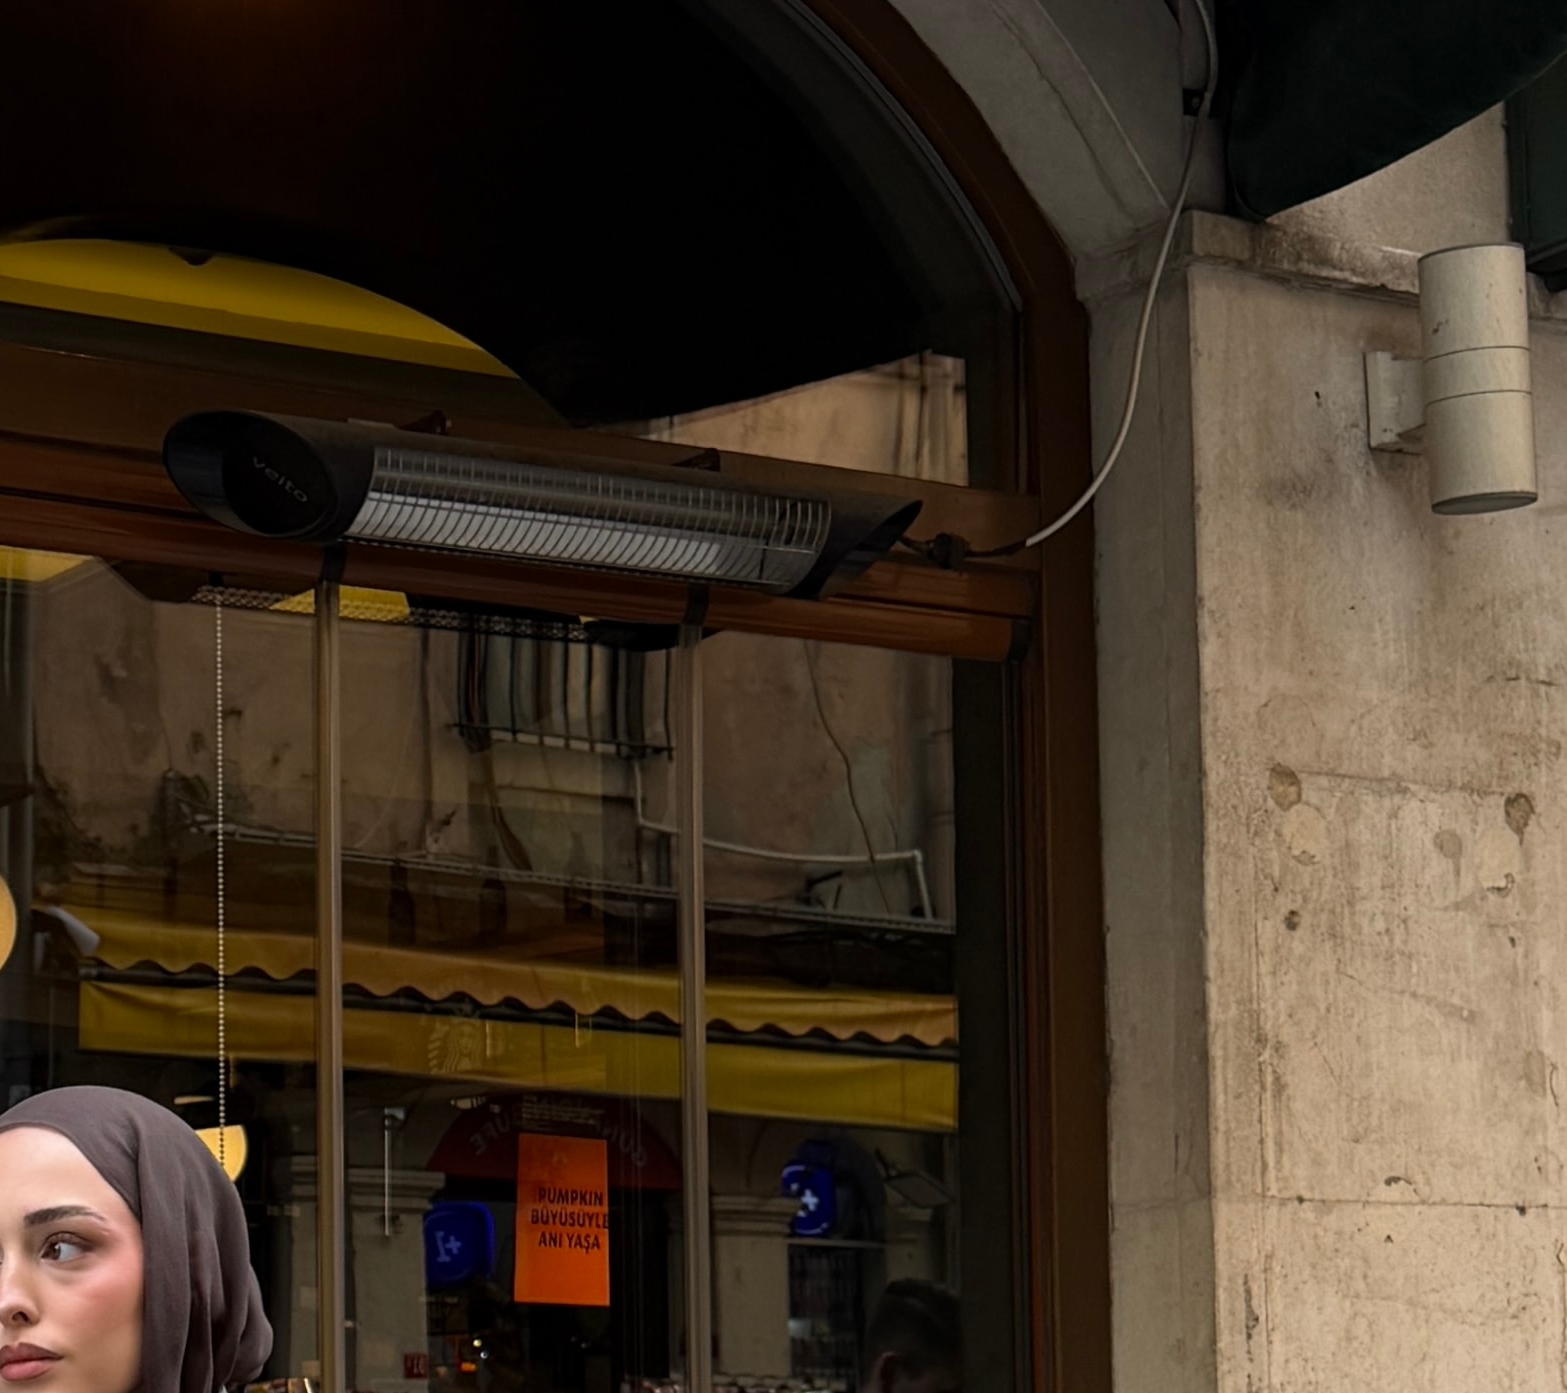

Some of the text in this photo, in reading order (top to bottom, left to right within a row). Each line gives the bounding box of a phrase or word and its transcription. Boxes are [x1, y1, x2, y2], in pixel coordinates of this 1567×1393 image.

[252, 455, 309, 503] veito
[538, 1186, 604, 1207] PUMPKIN
[538, 1231, 601, 1255] ANI YAŞA
